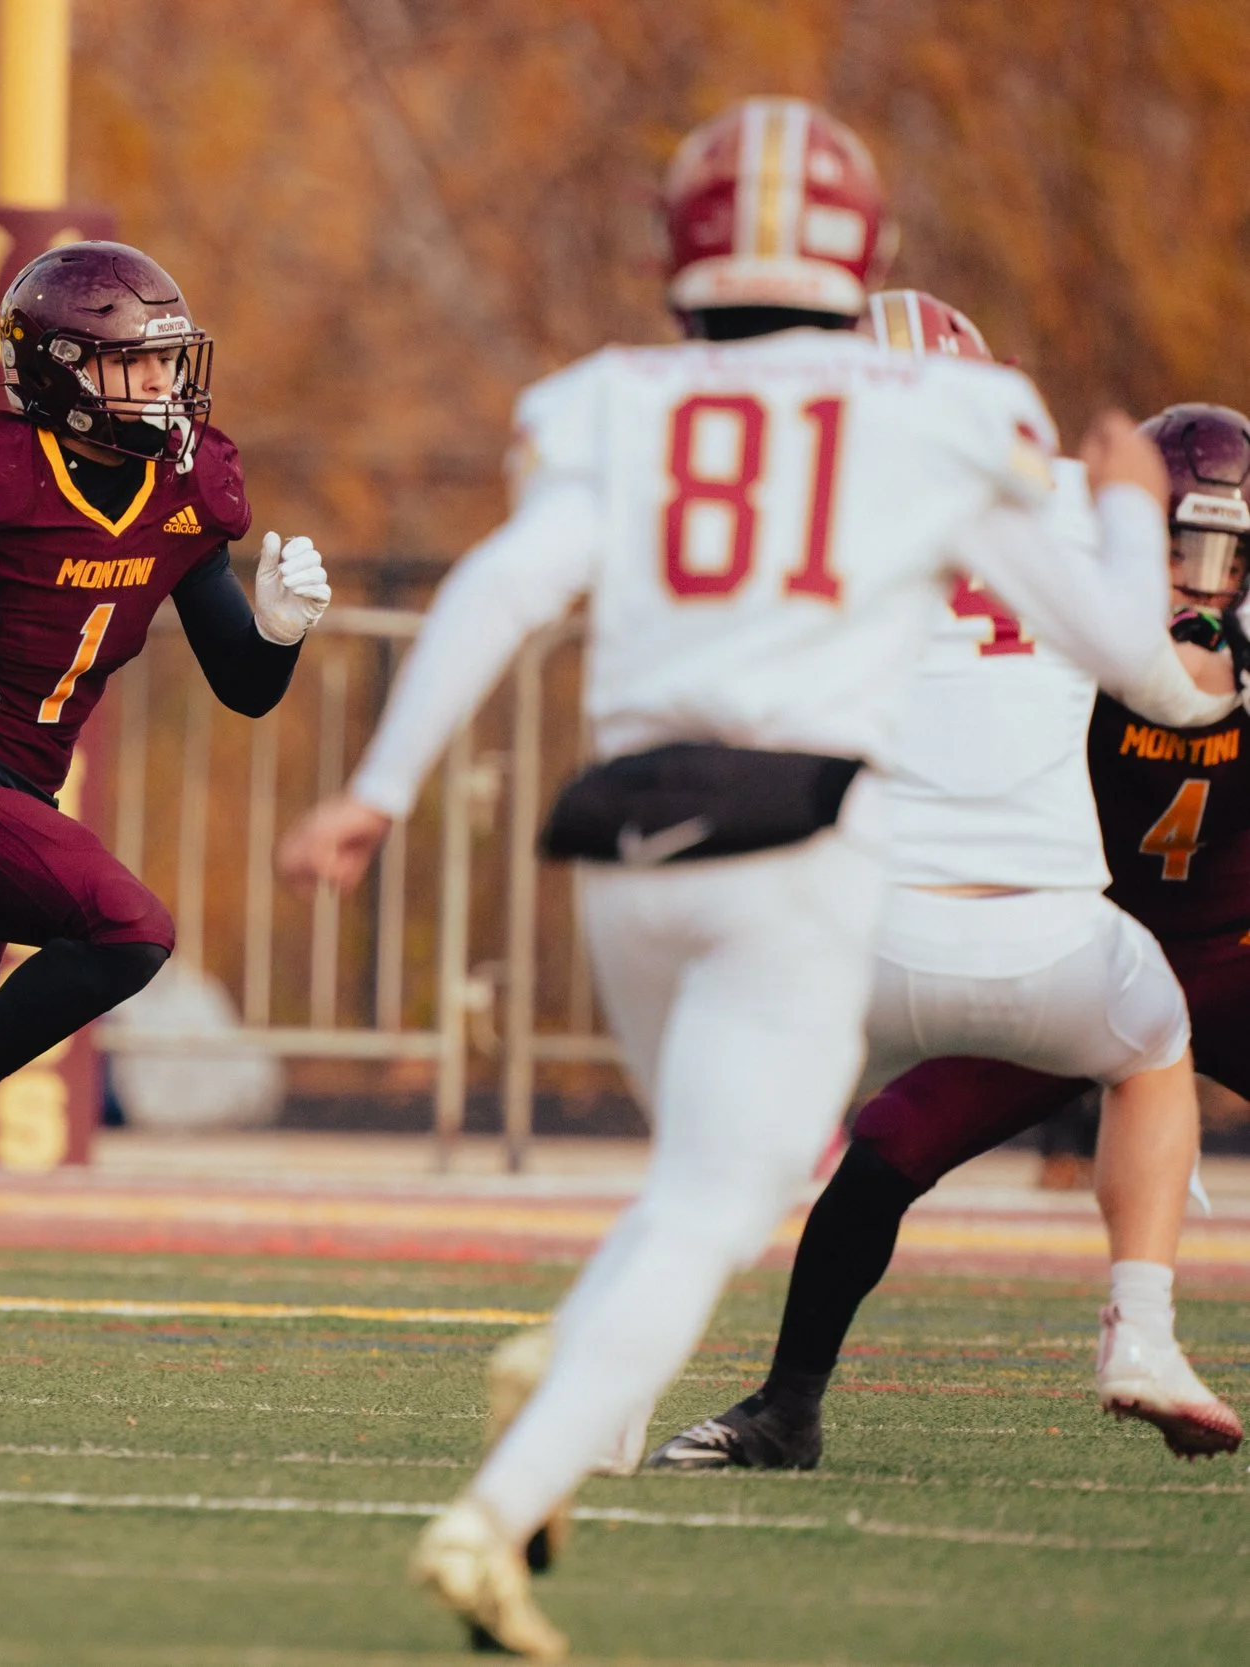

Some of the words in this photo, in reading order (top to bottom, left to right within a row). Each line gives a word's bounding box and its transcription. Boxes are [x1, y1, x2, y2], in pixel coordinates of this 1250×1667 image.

[163, 522, 202, 534] adidas
[660, 393, 845, 605] 81
[56, 557, 156, 589] MONTINI
[37, 603, 116, 723] 1
[1119, 723, 1240, 767] MONTINI
[1139, 778, 1211, 881] 4
